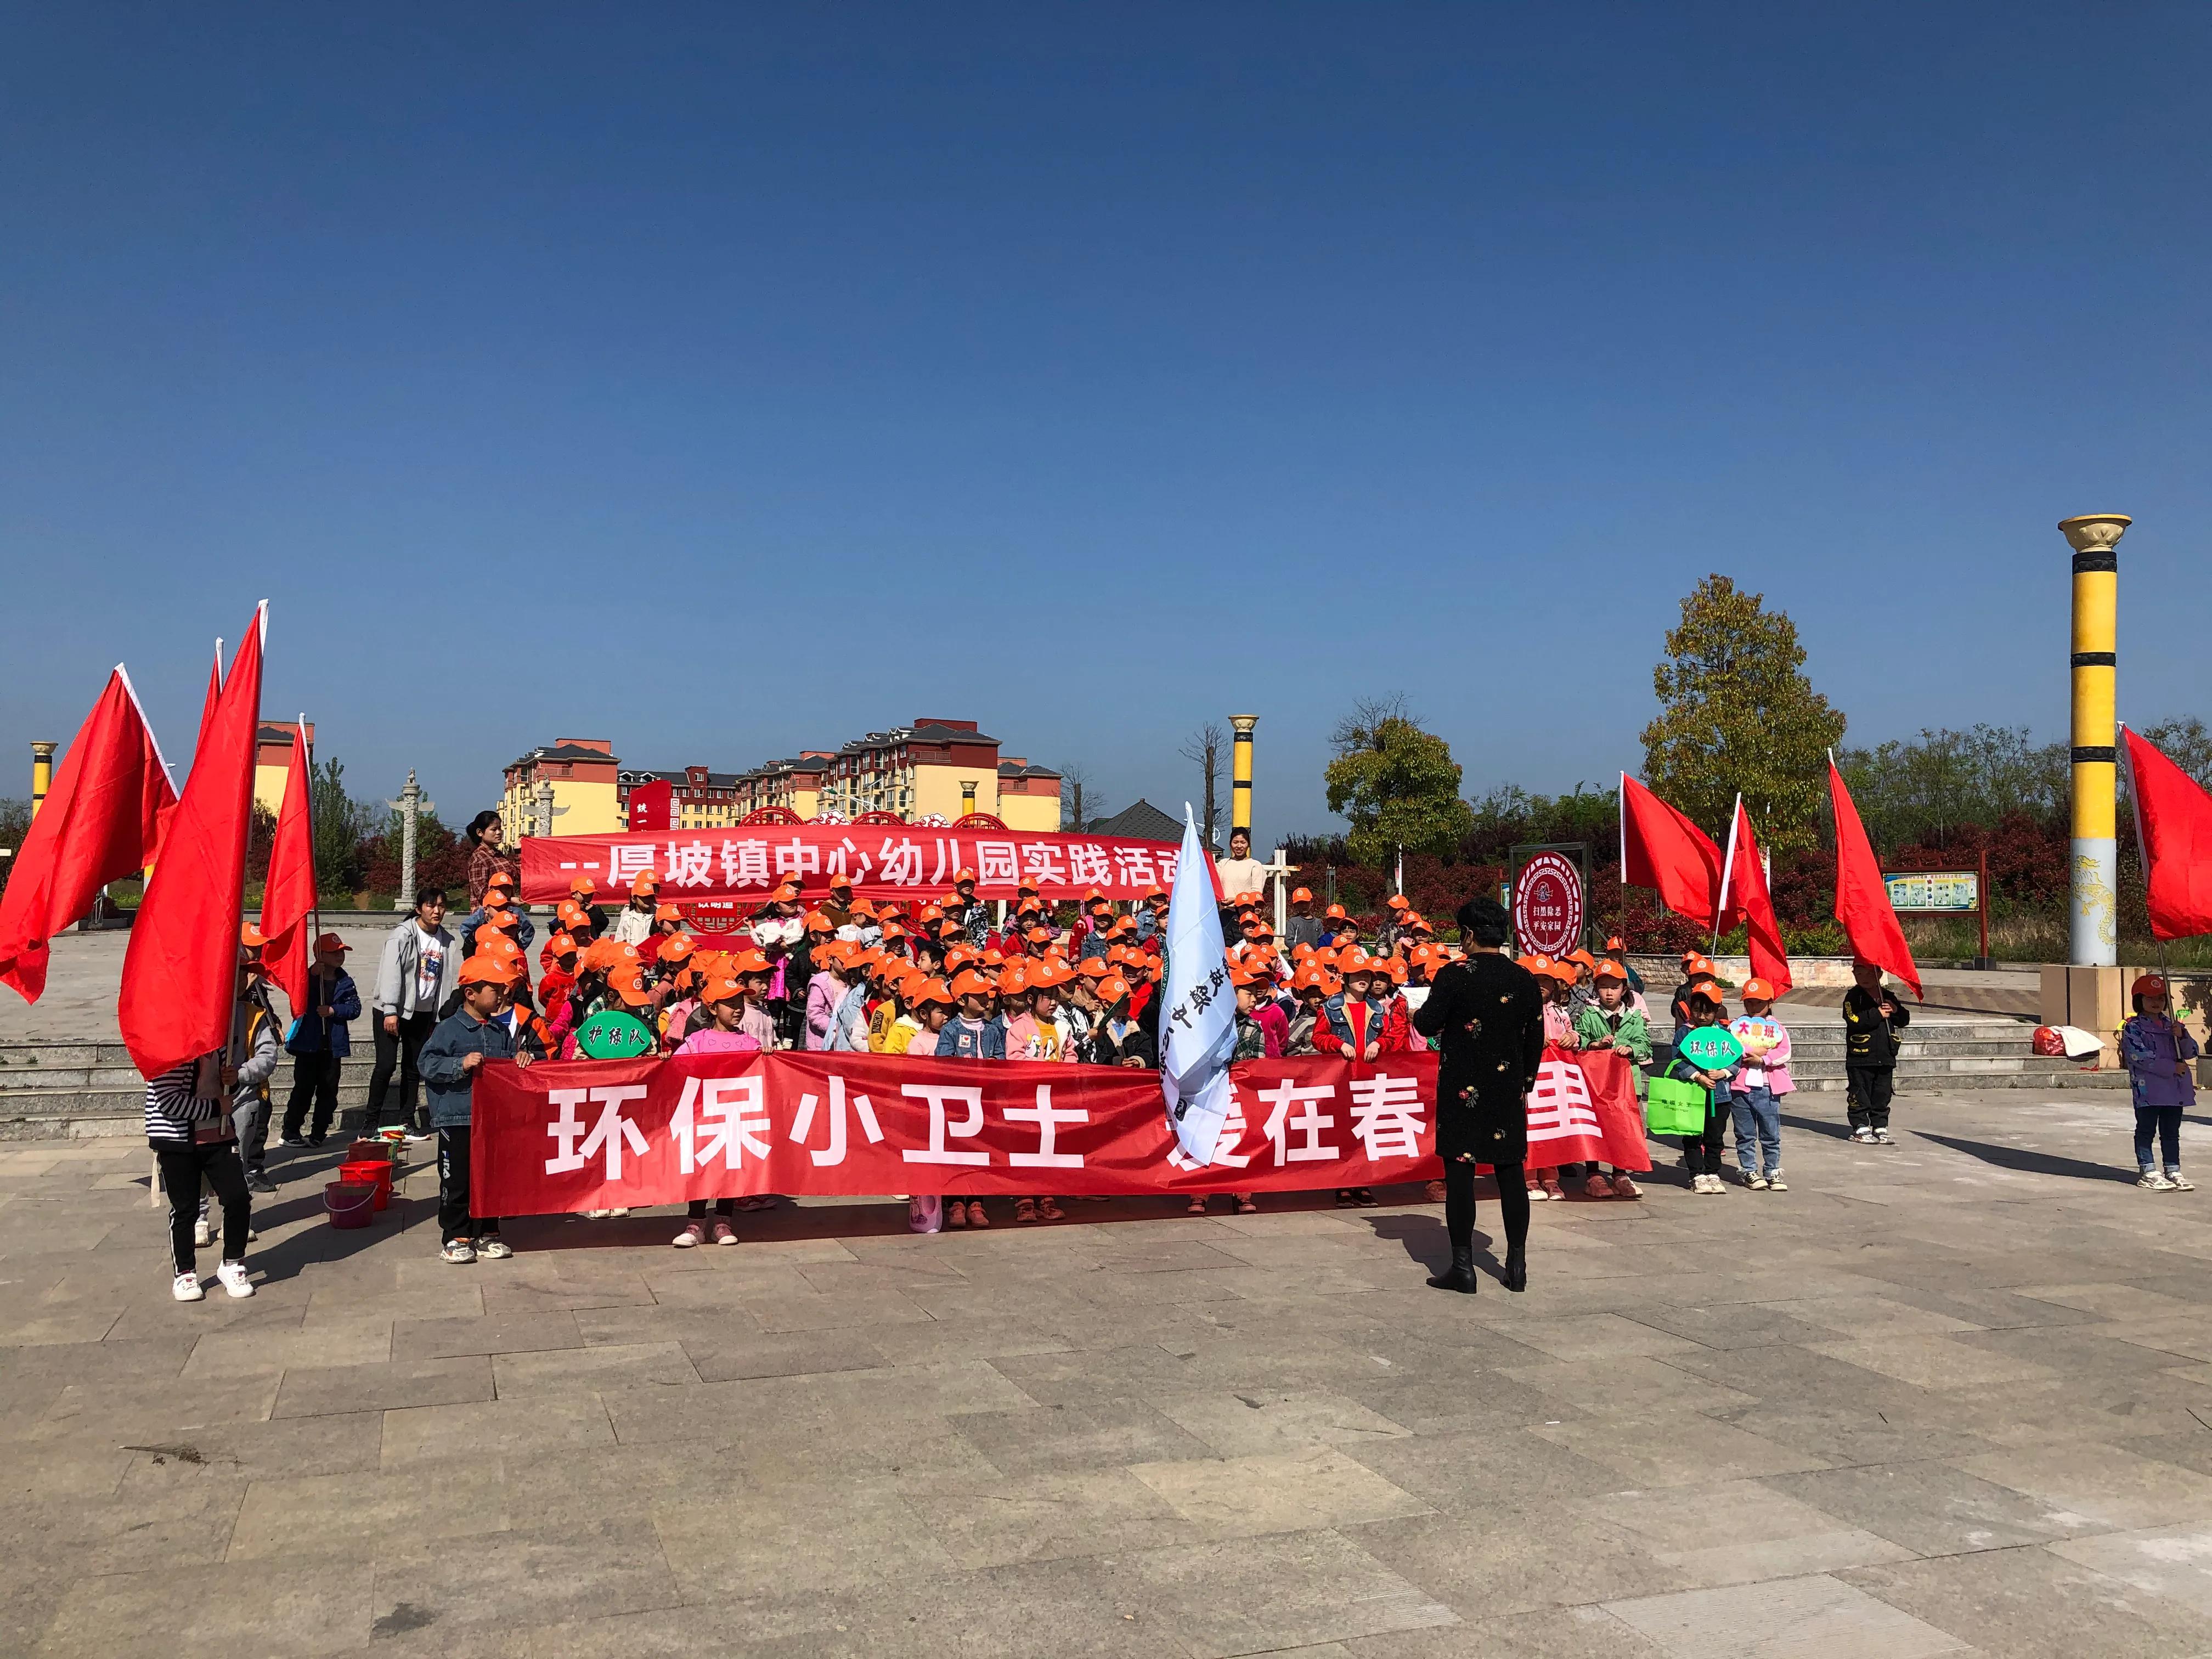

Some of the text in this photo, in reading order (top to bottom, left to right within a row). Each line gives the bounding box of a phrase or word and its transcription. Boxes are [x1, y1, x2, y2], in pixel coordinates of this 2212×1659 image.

[1533, 906, 1561, 917] 扫黑除恶
[1533, 921, 1561, 932] 平安家园
[588, 1025, 646, 1046] 护绿队
[1690, 1041, 1736, 1057] 环保队
[544, 1075, 1089, 1181] 环保小卫士
